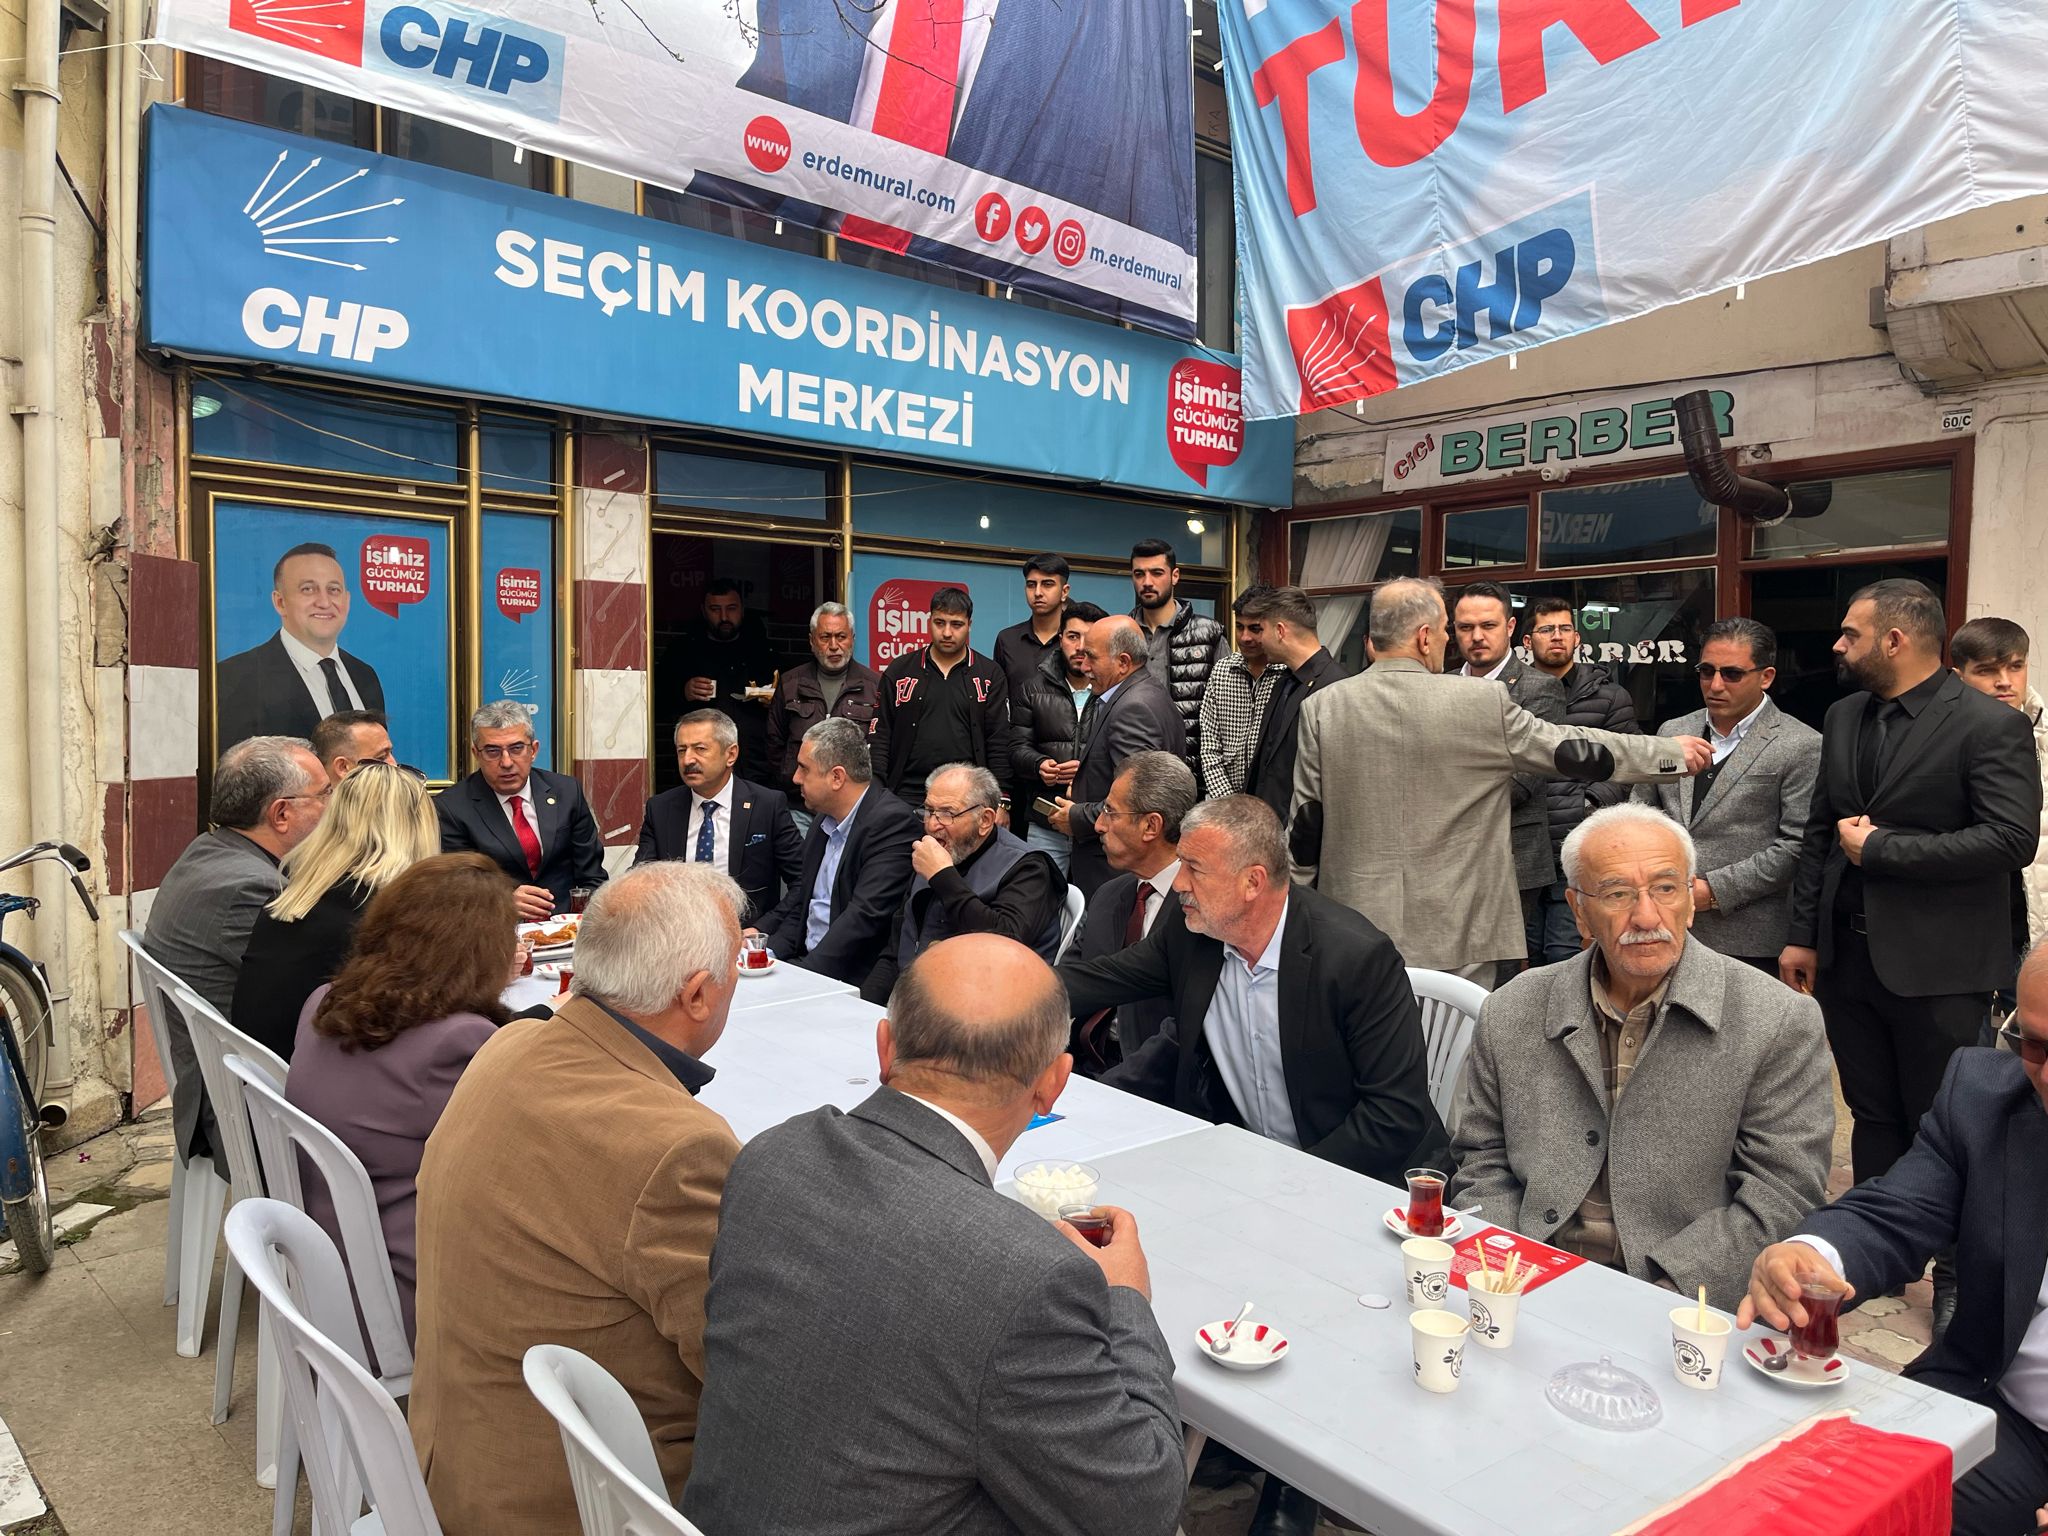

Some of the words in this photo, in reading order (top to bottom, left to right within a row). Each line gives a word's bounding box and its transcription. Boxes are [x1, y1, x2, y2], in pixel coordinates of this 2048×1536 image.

[380, 6, 549, 94] CHP
[1253, 0, 1741, 219] TUR
[747, 134, 789, 158] www
[802, 151, 956, 214] erdemural.com
[1089, 245, 1182, 290] m.erdemural
[1403, 228, 1576, 361] CHP
[242, 287, 410, 363] CHP
[494, 230, 705, 323] SEÇİM
[727, 279, 1131, 405] KOORDİNASYON
[738, 363, 974, 448] MERKEZİ
[1175, 372, 1240, 412] işimiz
[1173, 405, 1239, 432] GÜCÜMÜZ
[1943, 415, 1971, 428] 60/C
[1174, 426, 1238, 452] TURHAL
[366, 566, 425, 581] GÜCÜMÜZ
[367, 580, 425, 594] TURHAL
[500, 589, 538, 598] GÜCÜMÜZ
[500, 598, 538, 607] TURHAL
[877, 599, 931, 637] işim
